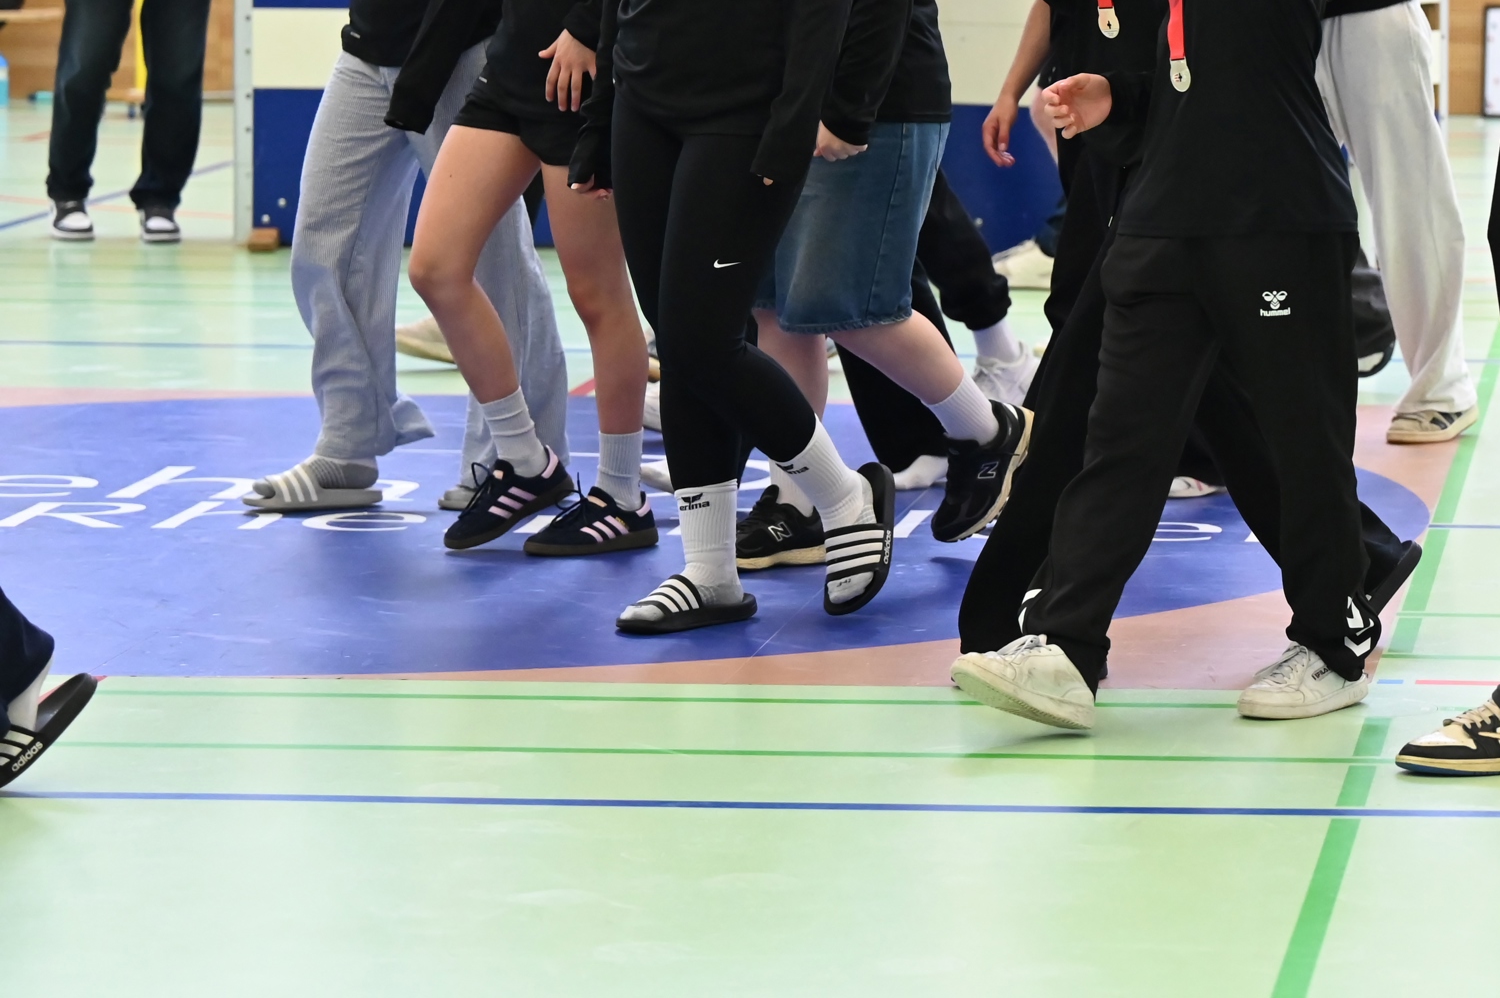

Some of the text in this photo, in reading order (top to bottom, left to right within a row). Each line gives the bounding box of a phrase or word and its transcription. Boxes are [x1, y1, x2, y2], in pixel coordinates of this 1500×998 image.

[1260, 306, 1291, 317] hummel
[679, 500, 711, 512] erima
[883, 529, 892, 565] adidas
[11, 741, 44, 772] adidas
